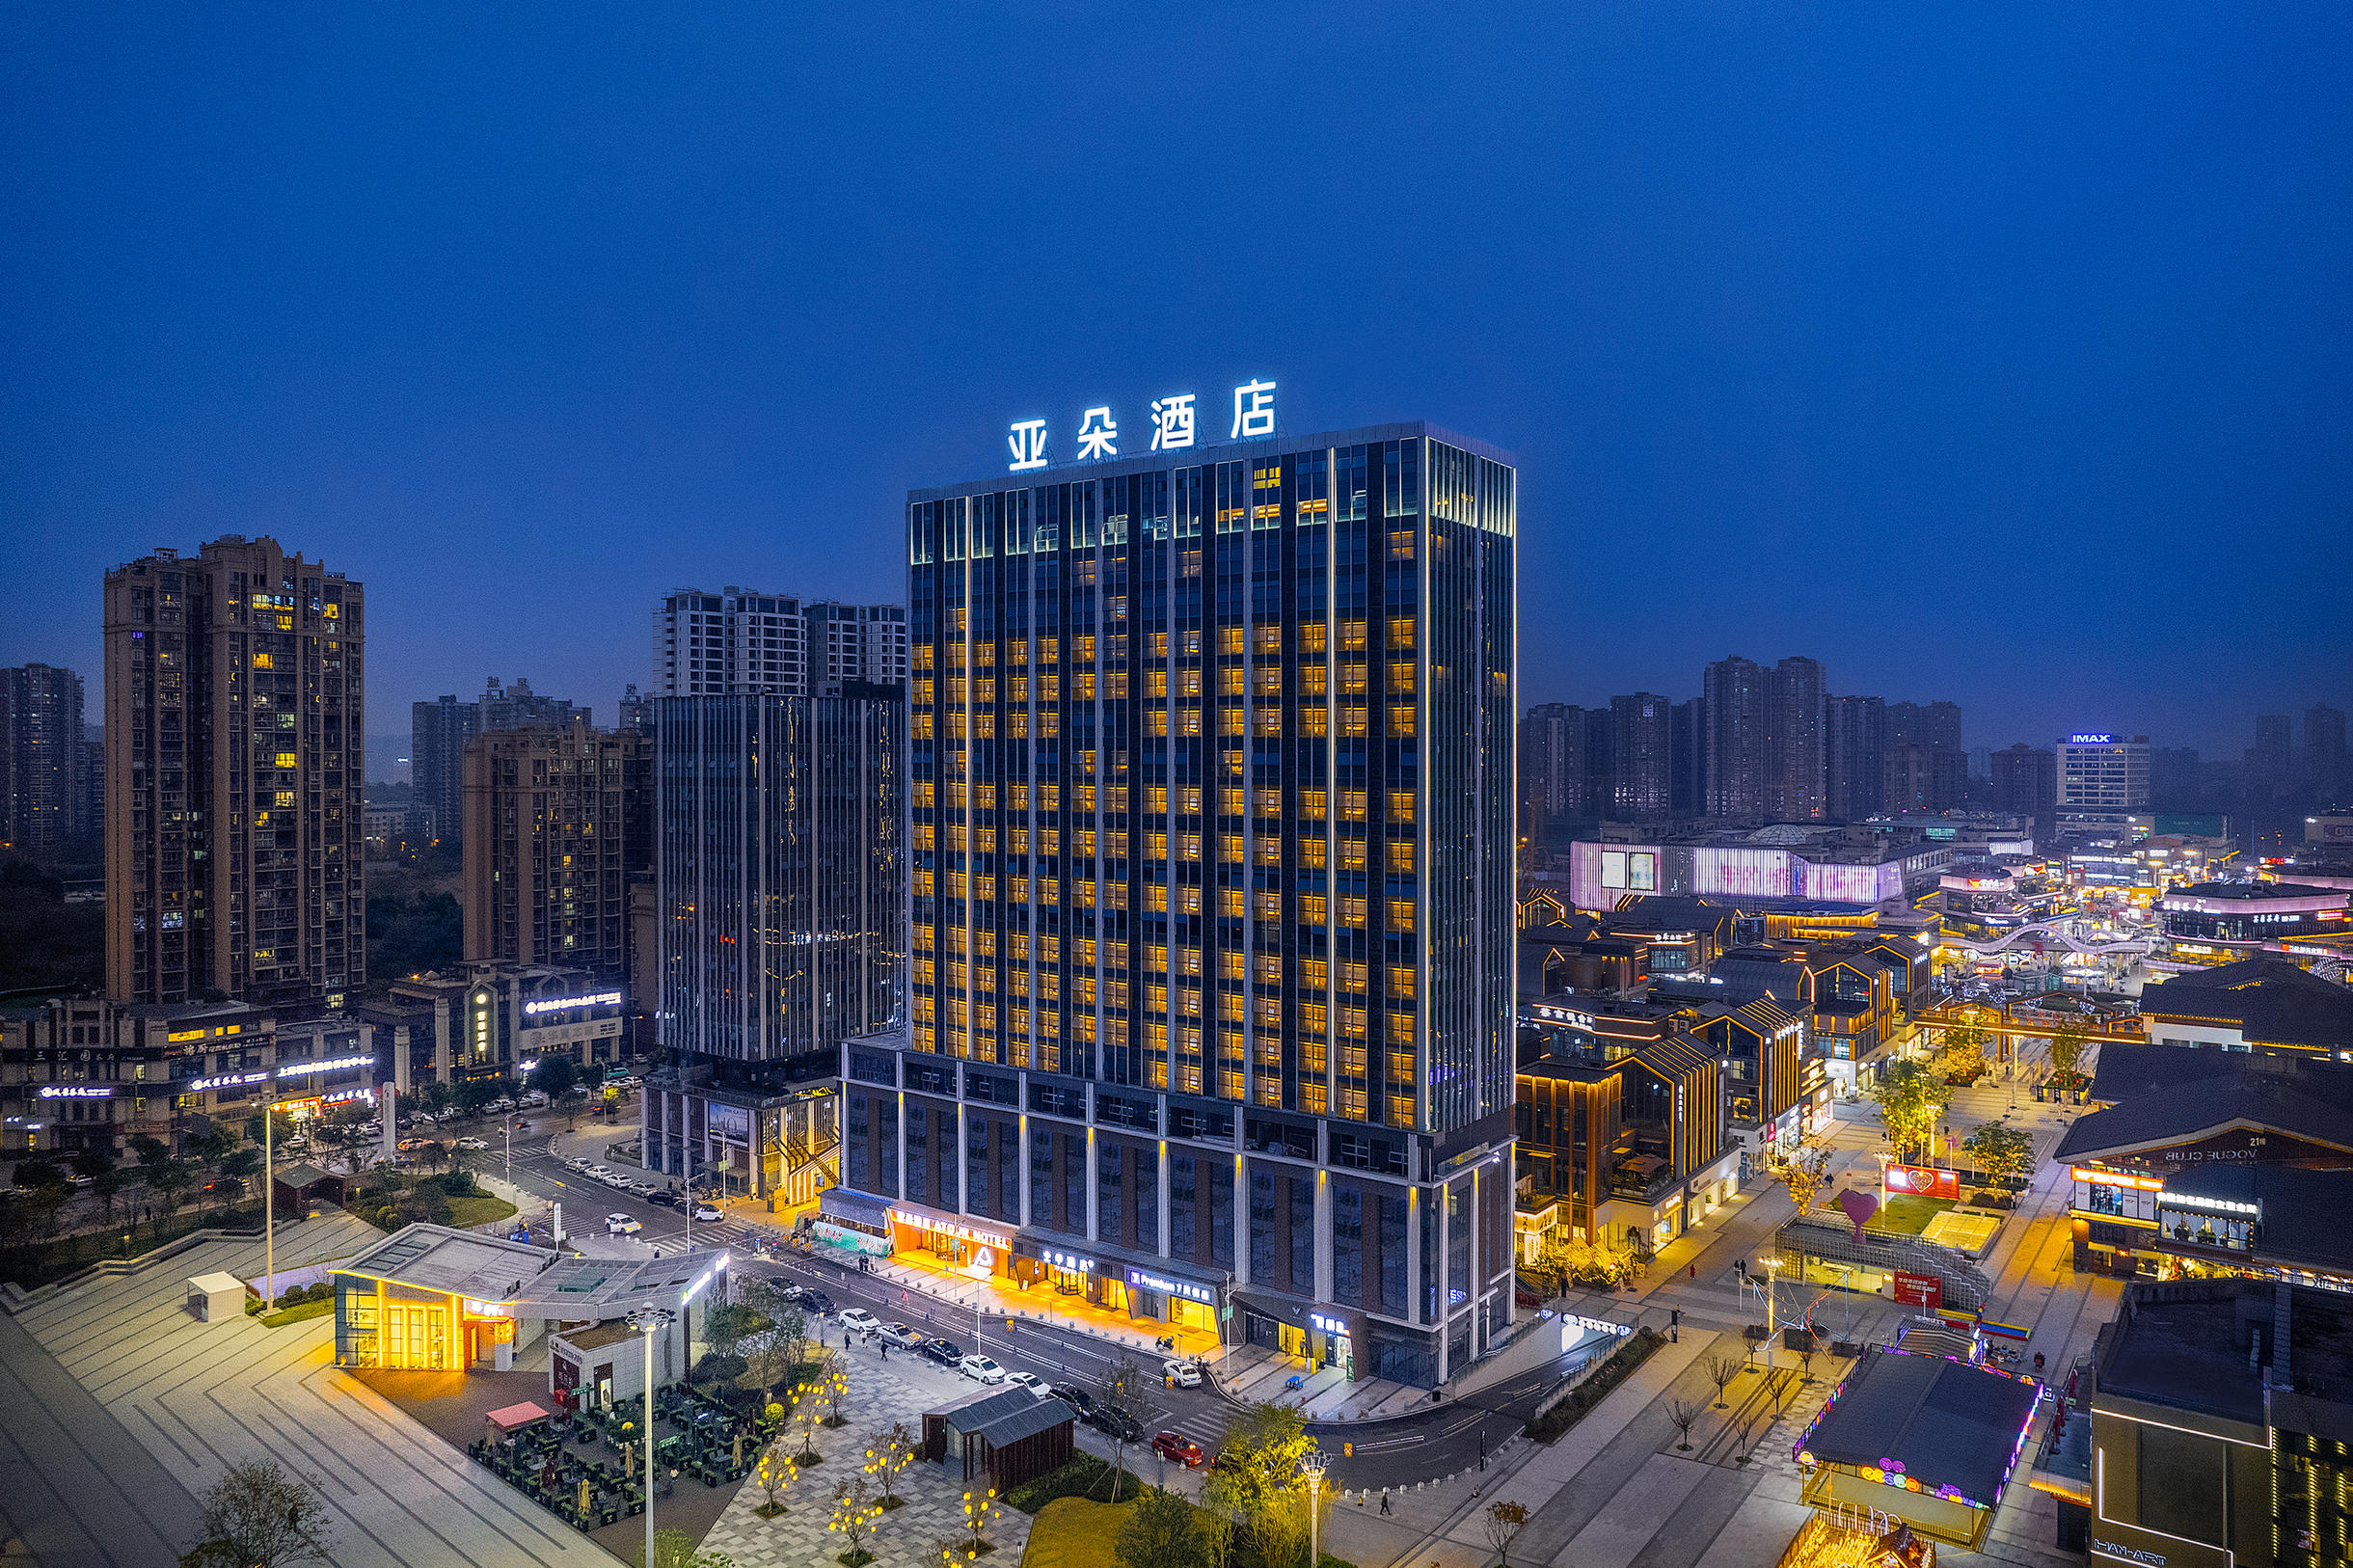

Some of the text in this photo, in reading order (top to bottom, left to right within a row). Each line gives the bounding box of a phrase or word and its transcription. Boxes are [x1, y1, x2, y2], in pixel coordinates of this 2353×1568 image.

[1008, 378, 1277, 472] 亚朵酒店
[2072, 734, 2111, 743] IMAX
[933, 1220, 969, 1239] ATOUR
[972, 1229, 1009, 1250] HOTEL
